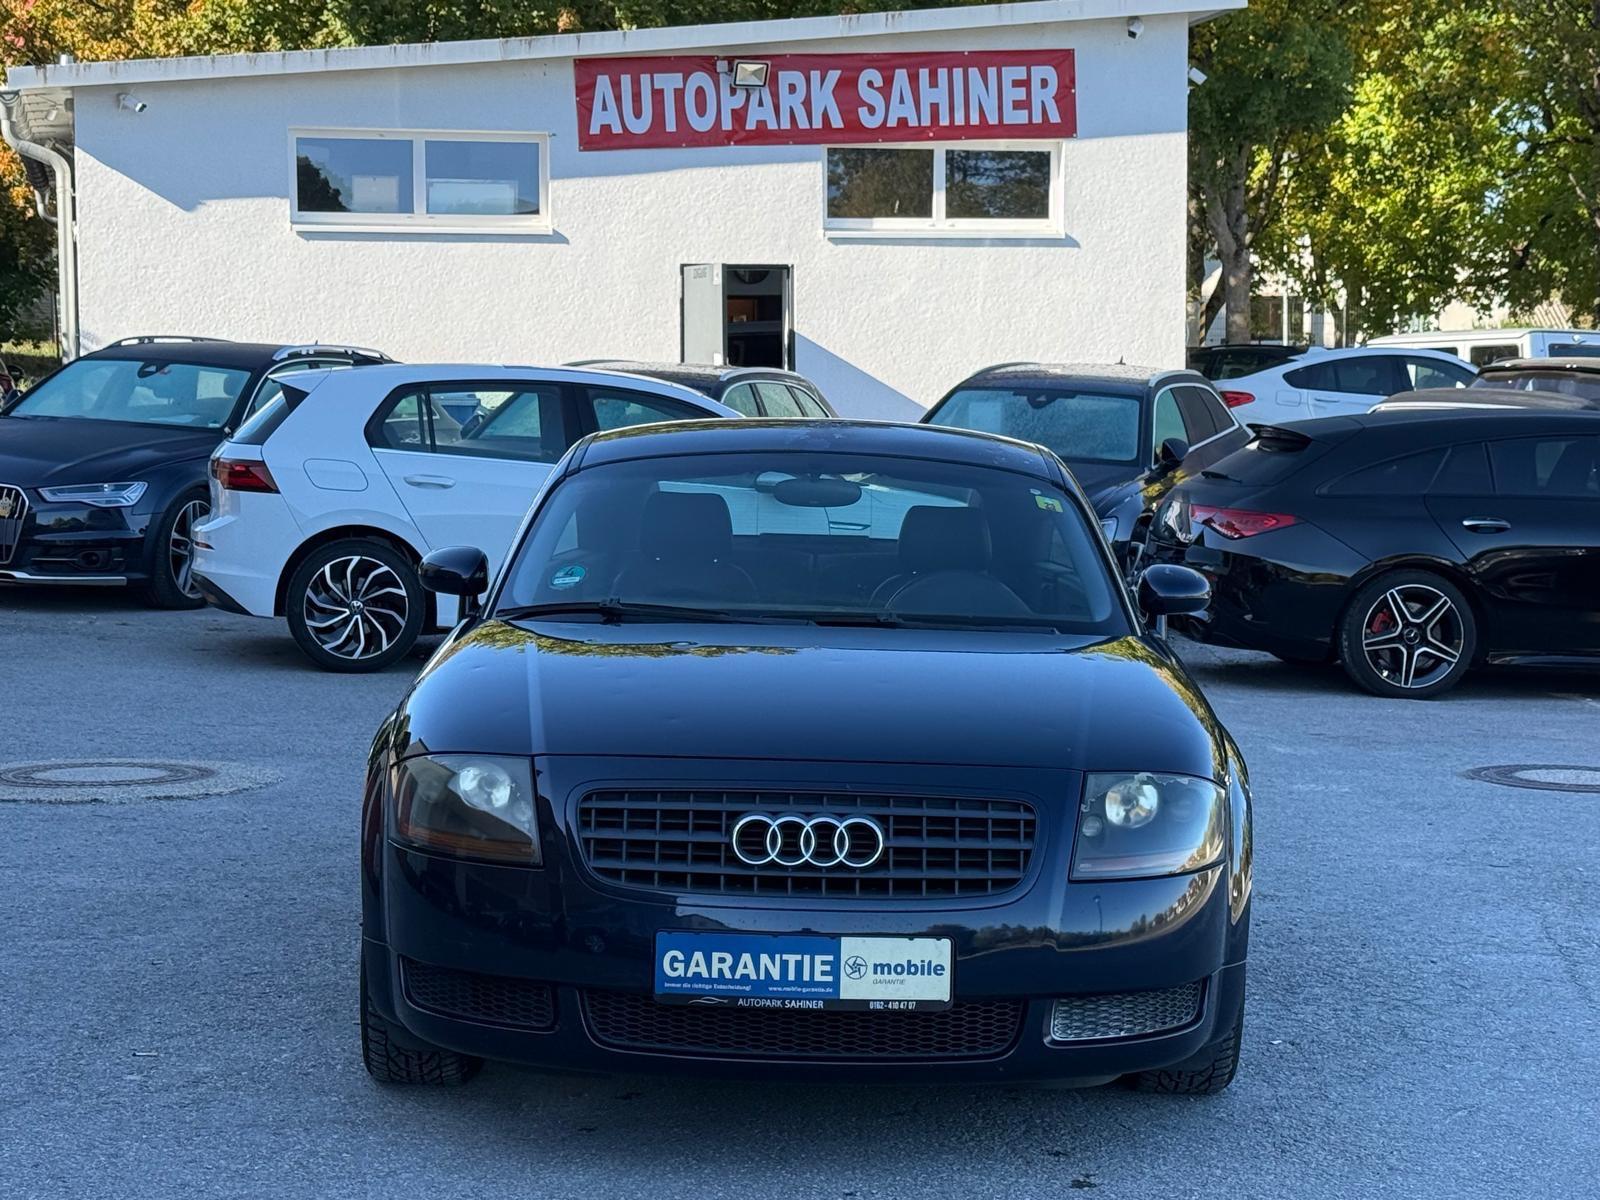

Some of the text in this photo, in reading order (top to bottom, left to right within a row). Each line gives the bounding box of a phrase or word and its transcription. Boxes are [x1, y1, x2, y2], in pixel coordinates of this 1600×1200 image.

[589, 65, 1062, 135] AUTOPARK SAHINER
[662, 949, 834, 982] GARANTIE
[873, 959, 946, 977] mobile
[737, 998, 824, 1009] AUTOPARK SAHINER
